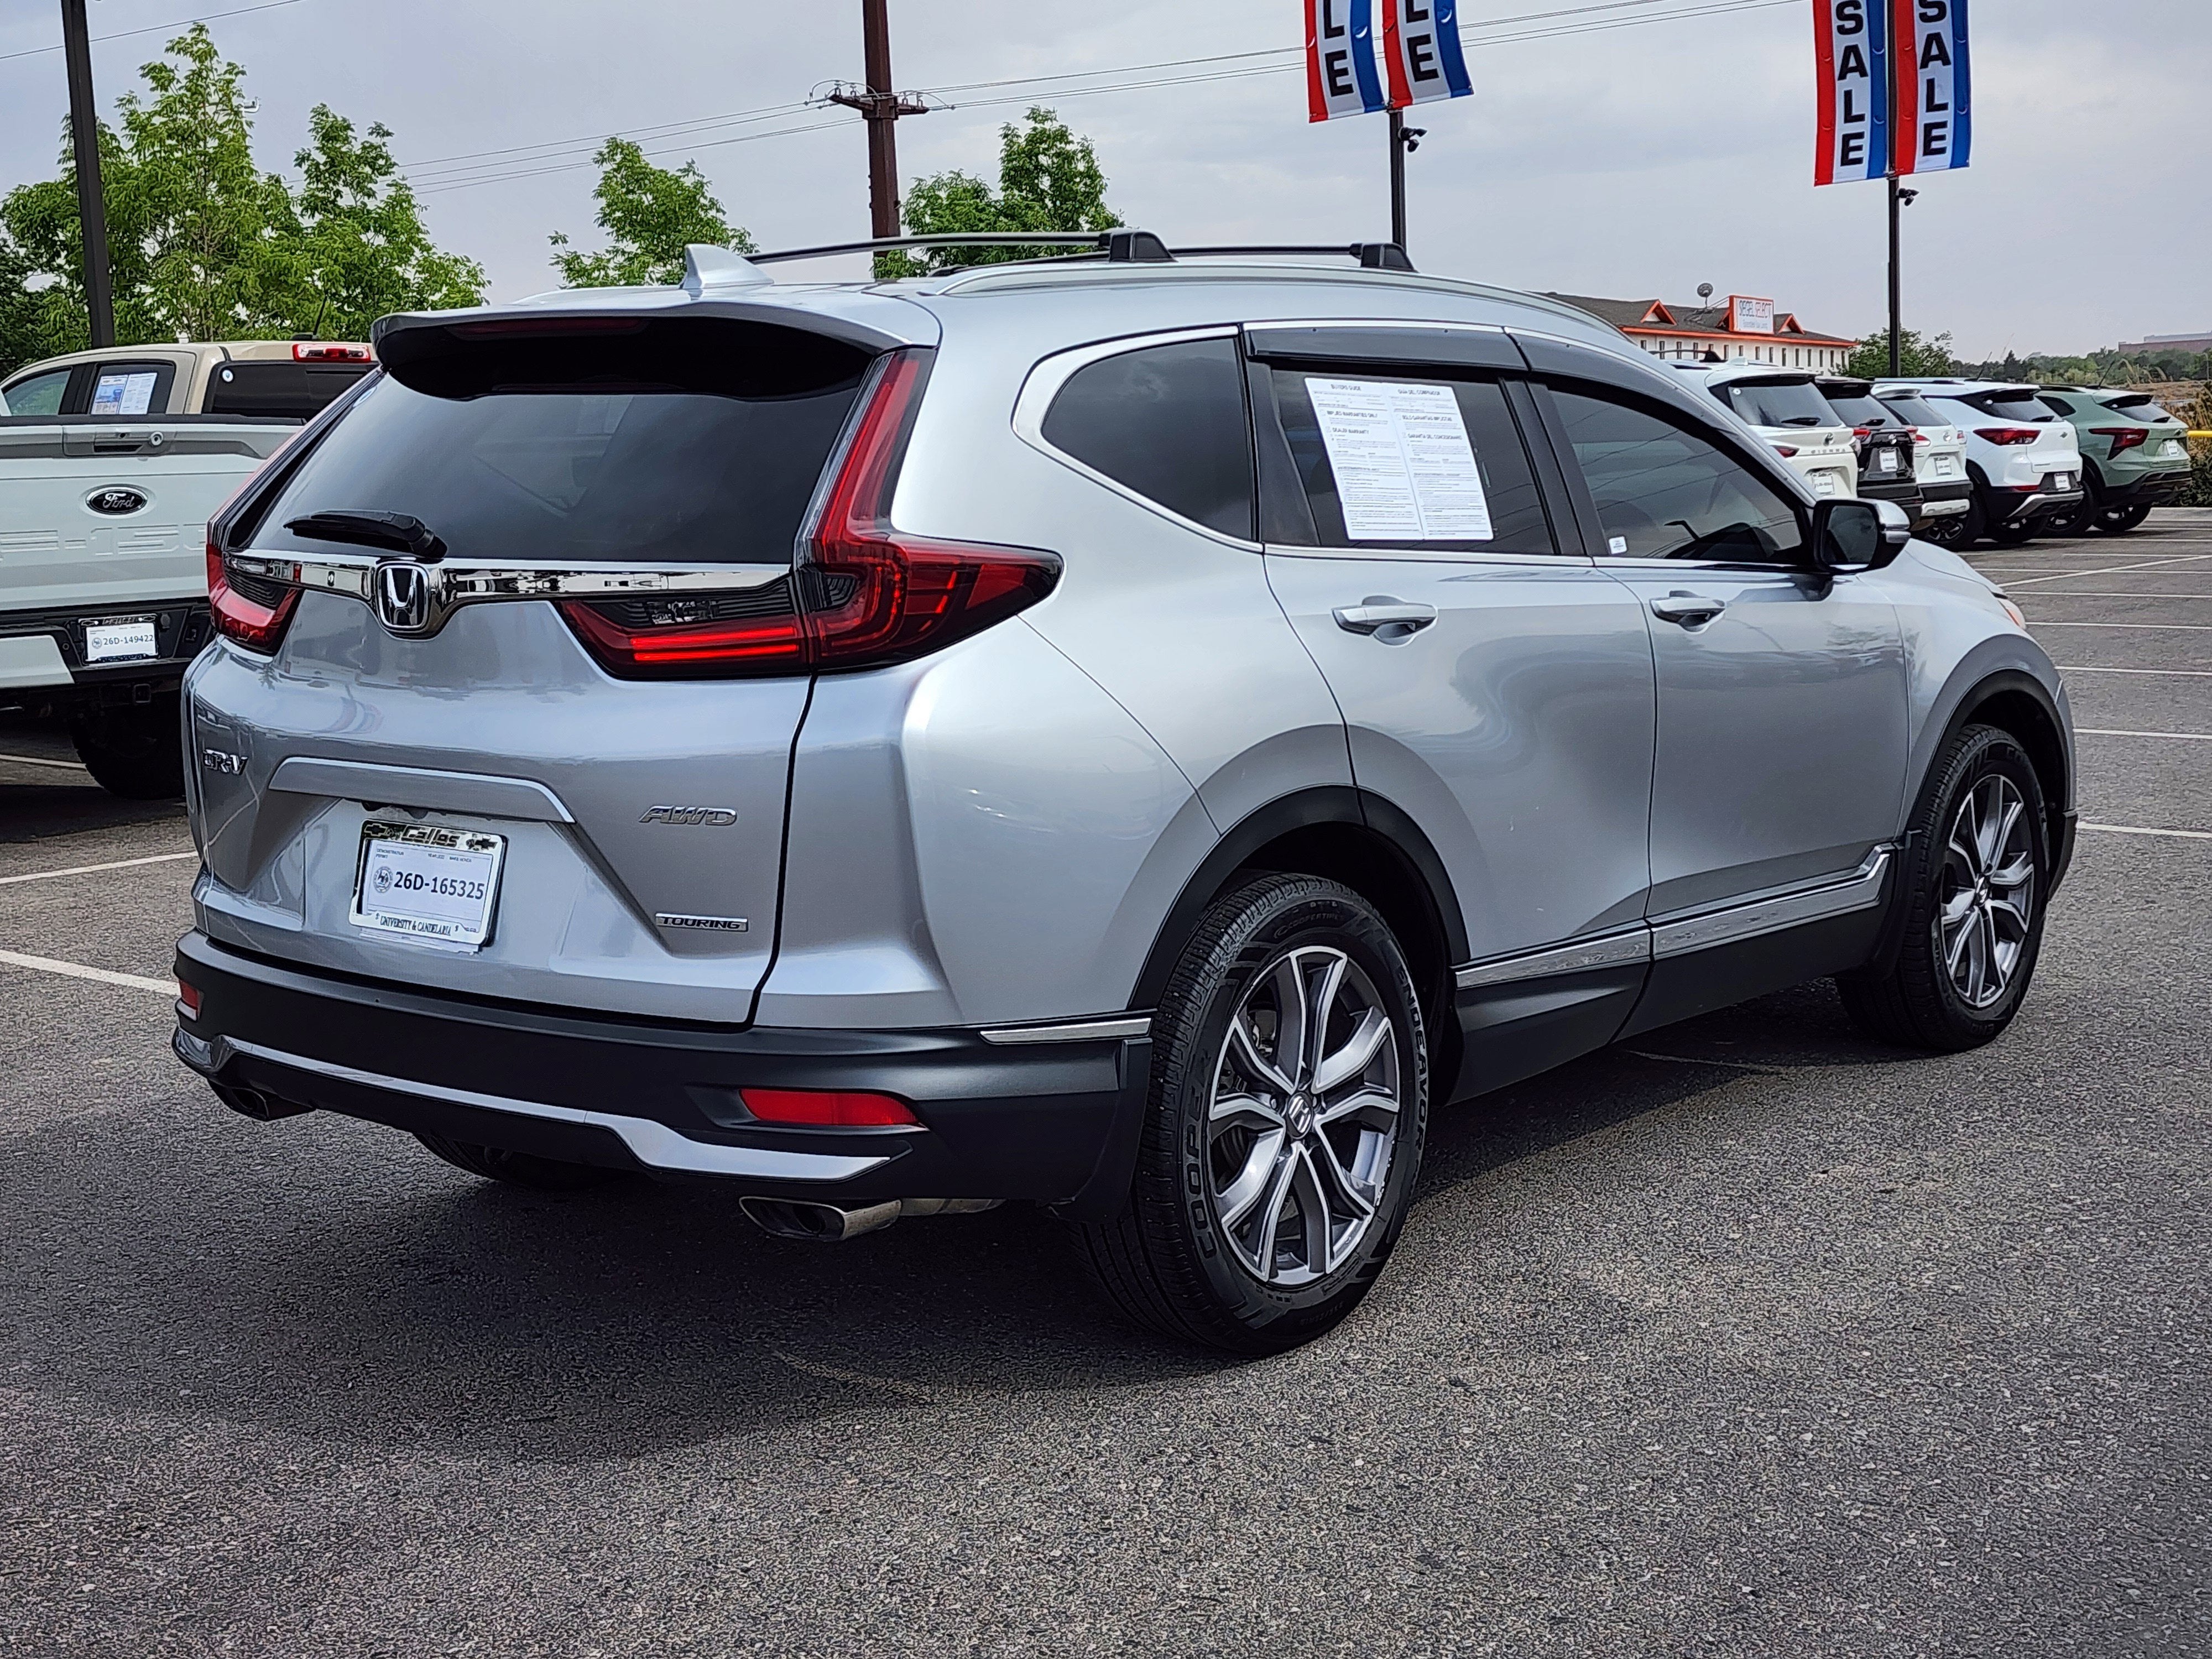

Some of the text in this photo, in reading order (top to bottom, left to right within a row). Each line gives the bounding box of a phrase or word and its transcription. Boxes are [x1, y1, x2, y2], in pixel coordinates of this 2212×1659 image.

[1835, 0, 1869, 167] SALE
[1918, 0, 1952, 157] SALE
[102, 492, 135, 509] Ford
[103, 635, 154, 645] 26D-149422
[203, 748, 249, 775] CR-V
[638, 805, 738, 826] AWD
[394, 871, 485, 900] 26D-165325
[380, 915, 412, 930] UNIVERSITY
[411, 922, 416, 931] &
[417, 922, 451, 936] CANDELARIA
[662, 917, 740, 930] TOURING
[1396, 964, 1427, 1152] ENDEAVOR
